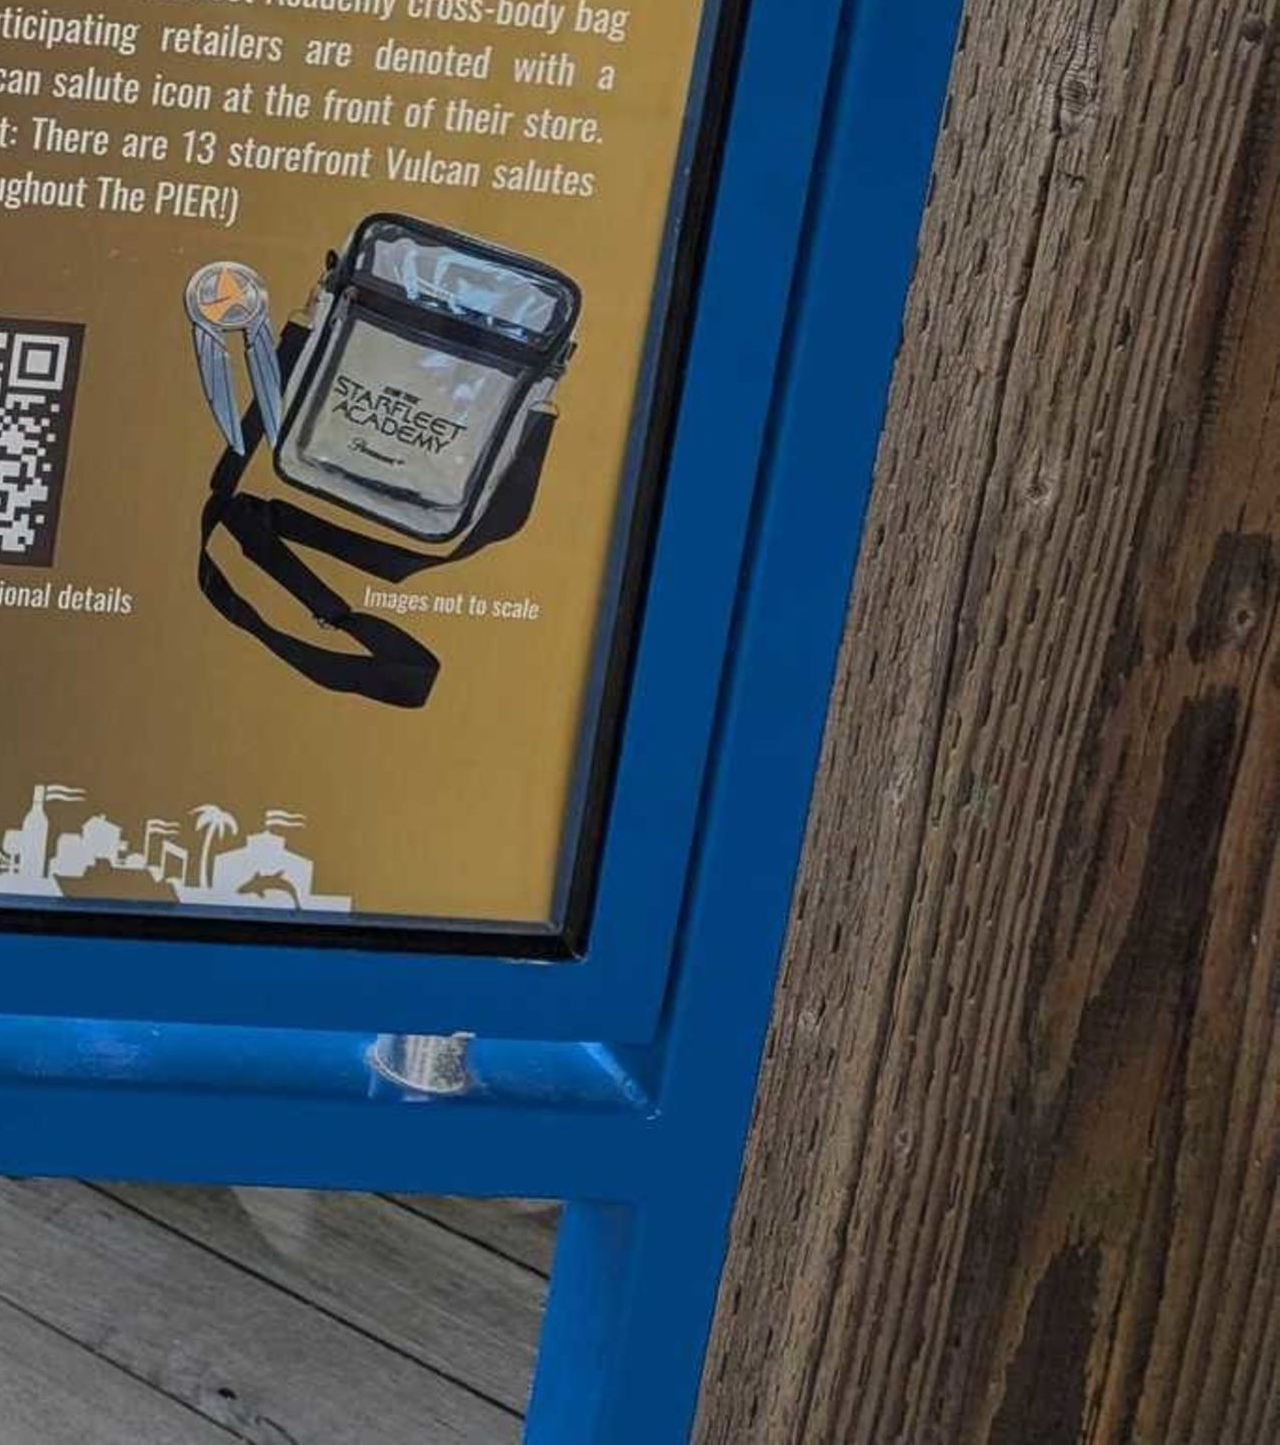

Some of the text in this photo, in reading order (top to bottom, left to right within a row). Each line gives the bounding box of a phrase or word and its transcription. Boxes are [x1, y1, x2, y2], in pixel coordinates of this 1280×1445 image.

[161, 23, 284, 62] retailers
[305, 40, 352, 67] are
[375, 40, 492, 80] denoted
[514, 52, 575, 88] with
[597, 64, 615, 91] a
[52, 66, 140, 105] salute
[152, 74, 211, 110] icon
[223, 82, 254, 115] at
[265, 84, 310, 119] the
[323, 88, 393, 126] front
[404, 97, 436, 129] of
[445, 99, 515, 136] their
[524, 112, 603, 145] store.
[32, 116, 109, 156] There
[122, 131, 168, 161] are
[183, 129, 216, 165] 13
[227, 136, 372, 179] storefront
[386, 147, 481, 188] Vulcan
[492, 159, 596, 198] salutes
[97, 176, 146, 214] The
[154, 181, 240, 228] PIER!)
[332, 400, 451, 454] ACADEMY
[333, 375, 467, 440] STARFLEET
[58, 583, 132, 615] details
[364, 585, 540, 620] Images not to scale
